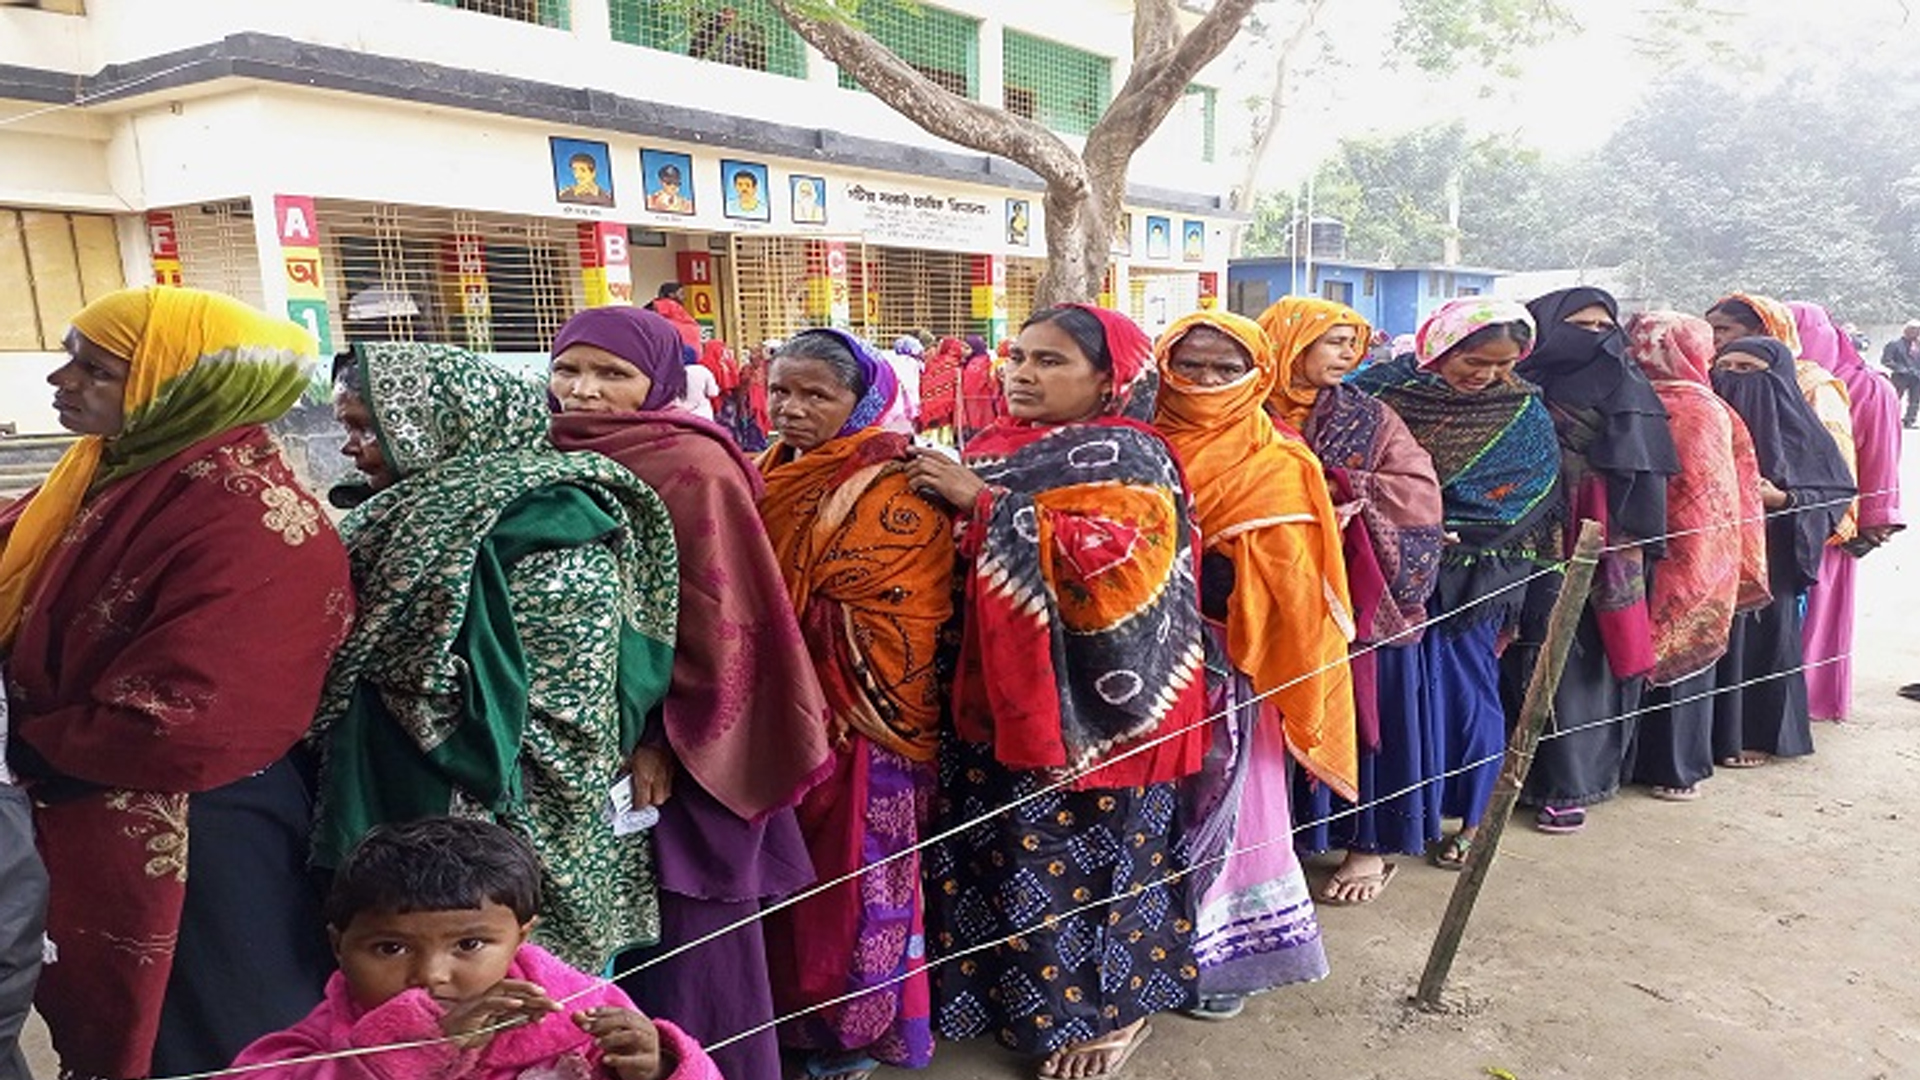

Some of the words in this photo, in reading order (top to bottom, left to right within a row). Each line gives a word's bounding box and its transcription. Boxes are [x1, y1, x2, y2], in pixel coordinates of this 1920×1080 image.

[284, 206, 309, 239] A
[604, 234, 627, 262] B
[286, 258, 319, 288] অ
[691, 260, 707, 281] H
